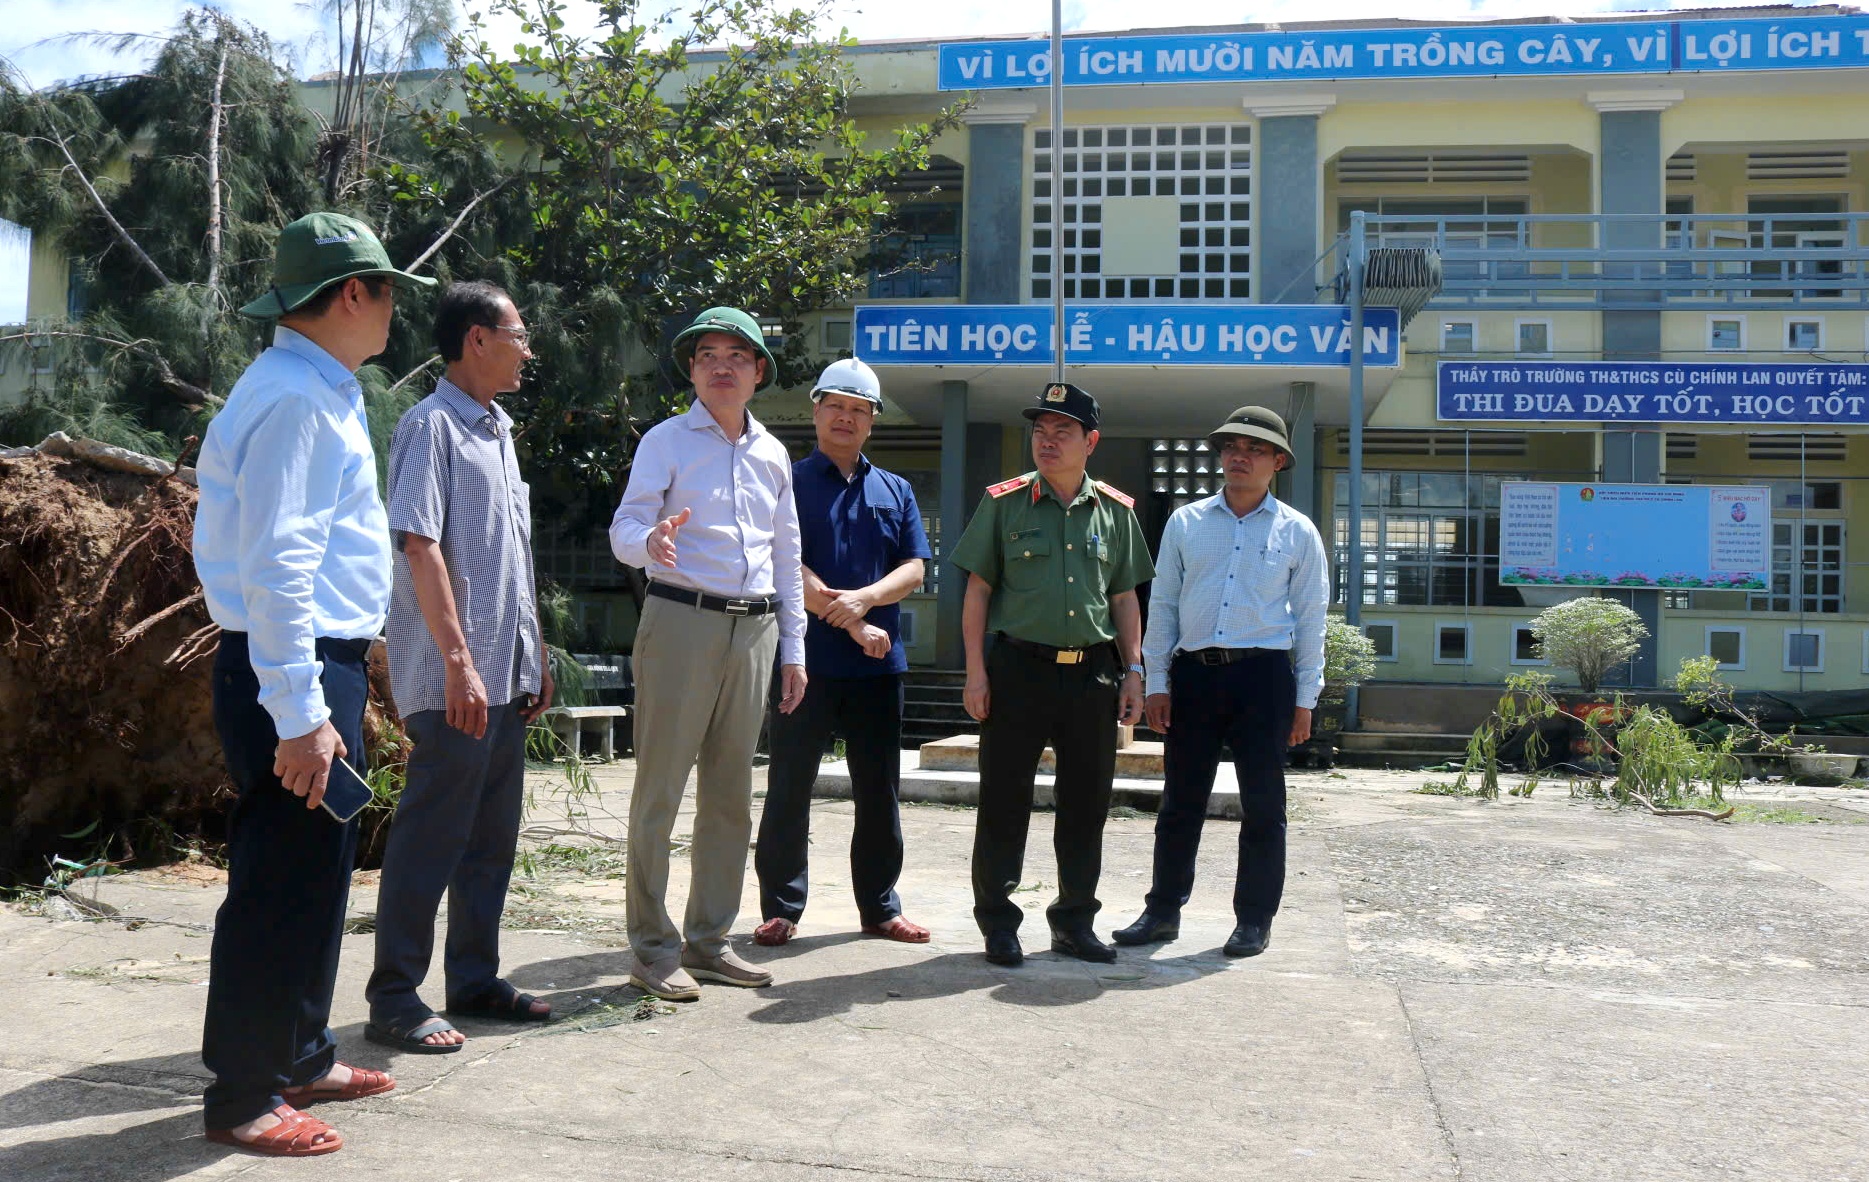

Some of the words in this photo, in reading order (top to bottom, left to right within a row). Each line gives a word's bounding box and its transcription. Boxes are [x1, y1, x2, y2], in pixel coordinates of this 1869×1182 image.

[957, 49, 993, 79] VÌ
[1078, 42, 1143, 75] ÍCH
[1156, 41, 1254, 72] MƯỜI
[1267, 39, 1354, 70] NĂM
[1366, 31, 1505, 68] TRỒNG
[1517, 33, 1613, 68] CÂY,
[1626, 30, 1667, 62] VÌ
[1686, 29, 1751, 67] LỢI
[1766, 25, 1839, 59] ÍCH
[865, 319, 948, 351] TIÊN
[961, 324, 1037, 359] HỌC
[1128, 318, 1205, 360] HẬU
[1218, 324, 1298, 360] HỌC
[1450, 365, 1488, 383] THẦY
[1491, 367, 1521, 383] TRÒ
[1525, 367, 1585, 384] TRƯỜNG
[1589, 371, 1659, 384] TH&THCS
[1664, 368, 1685, 384] CÙ
[1689, 368, 1737, 385] CHÍNH
[1742, 371, 1770, 385] LAN
[1775, 366, 1825, 386] QUYẾT
[1828, 369, 1867, 386] TÂM:
[1453, 393, 1504, 413] THI
[1514, 394, 1575, 413] ĐUA
[1583, 394, 1645, 419] DẠY
[1653, 386, 1721, 417] TỐT,
[1731, 395, 1795, 419] HỌC
[1804, 387, 1866, 416] TỐT
